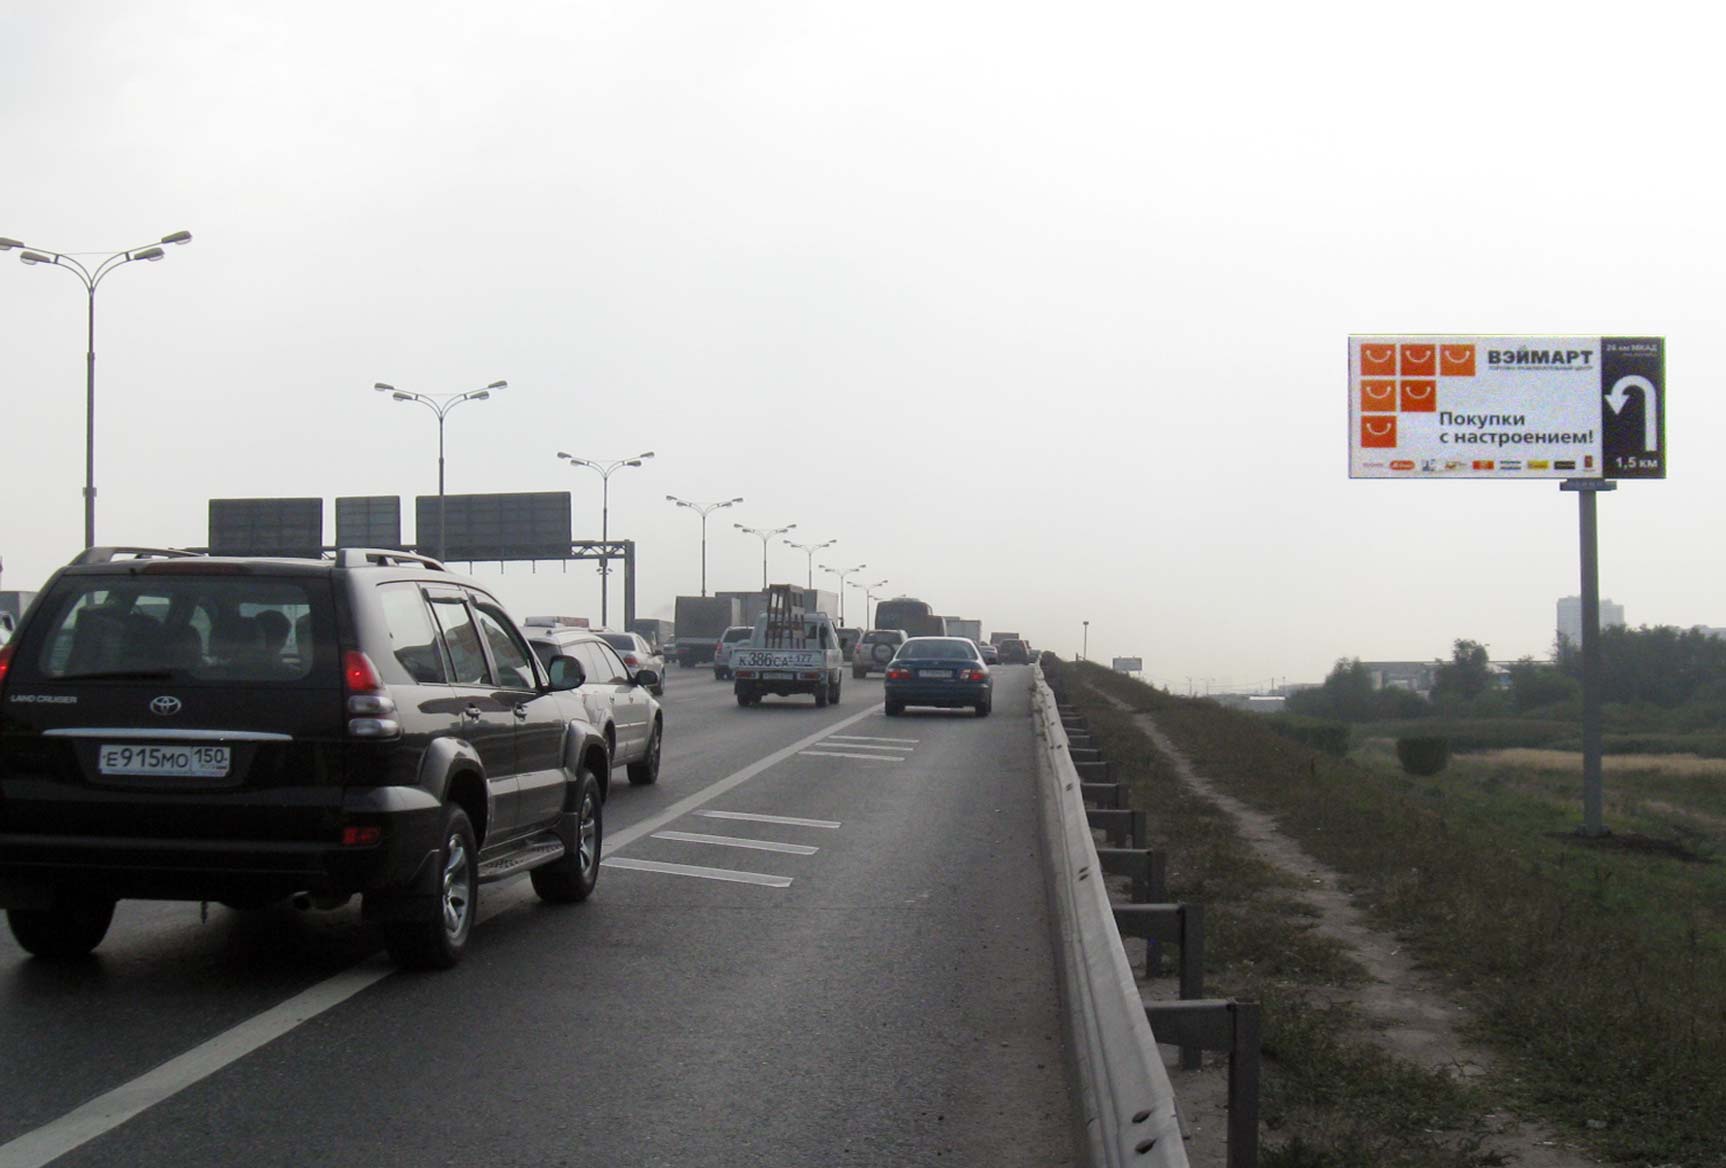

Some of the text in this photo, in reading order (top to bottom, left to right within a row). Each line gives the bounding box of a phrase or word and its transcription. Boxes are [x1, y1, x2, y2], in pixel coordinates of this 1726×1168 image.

[1488, 345, 1593, 365] ВЭЙМАРТ
[1440, 411, 1526, 429] Покупки
[1440, 429, 1594, 447] с настроением!
[1615, 456, 1658, 470] 1,5 км
[10, 694, 79, 704] LAND CRUISER
[105, 748, 225, 769] Е915МО 150
